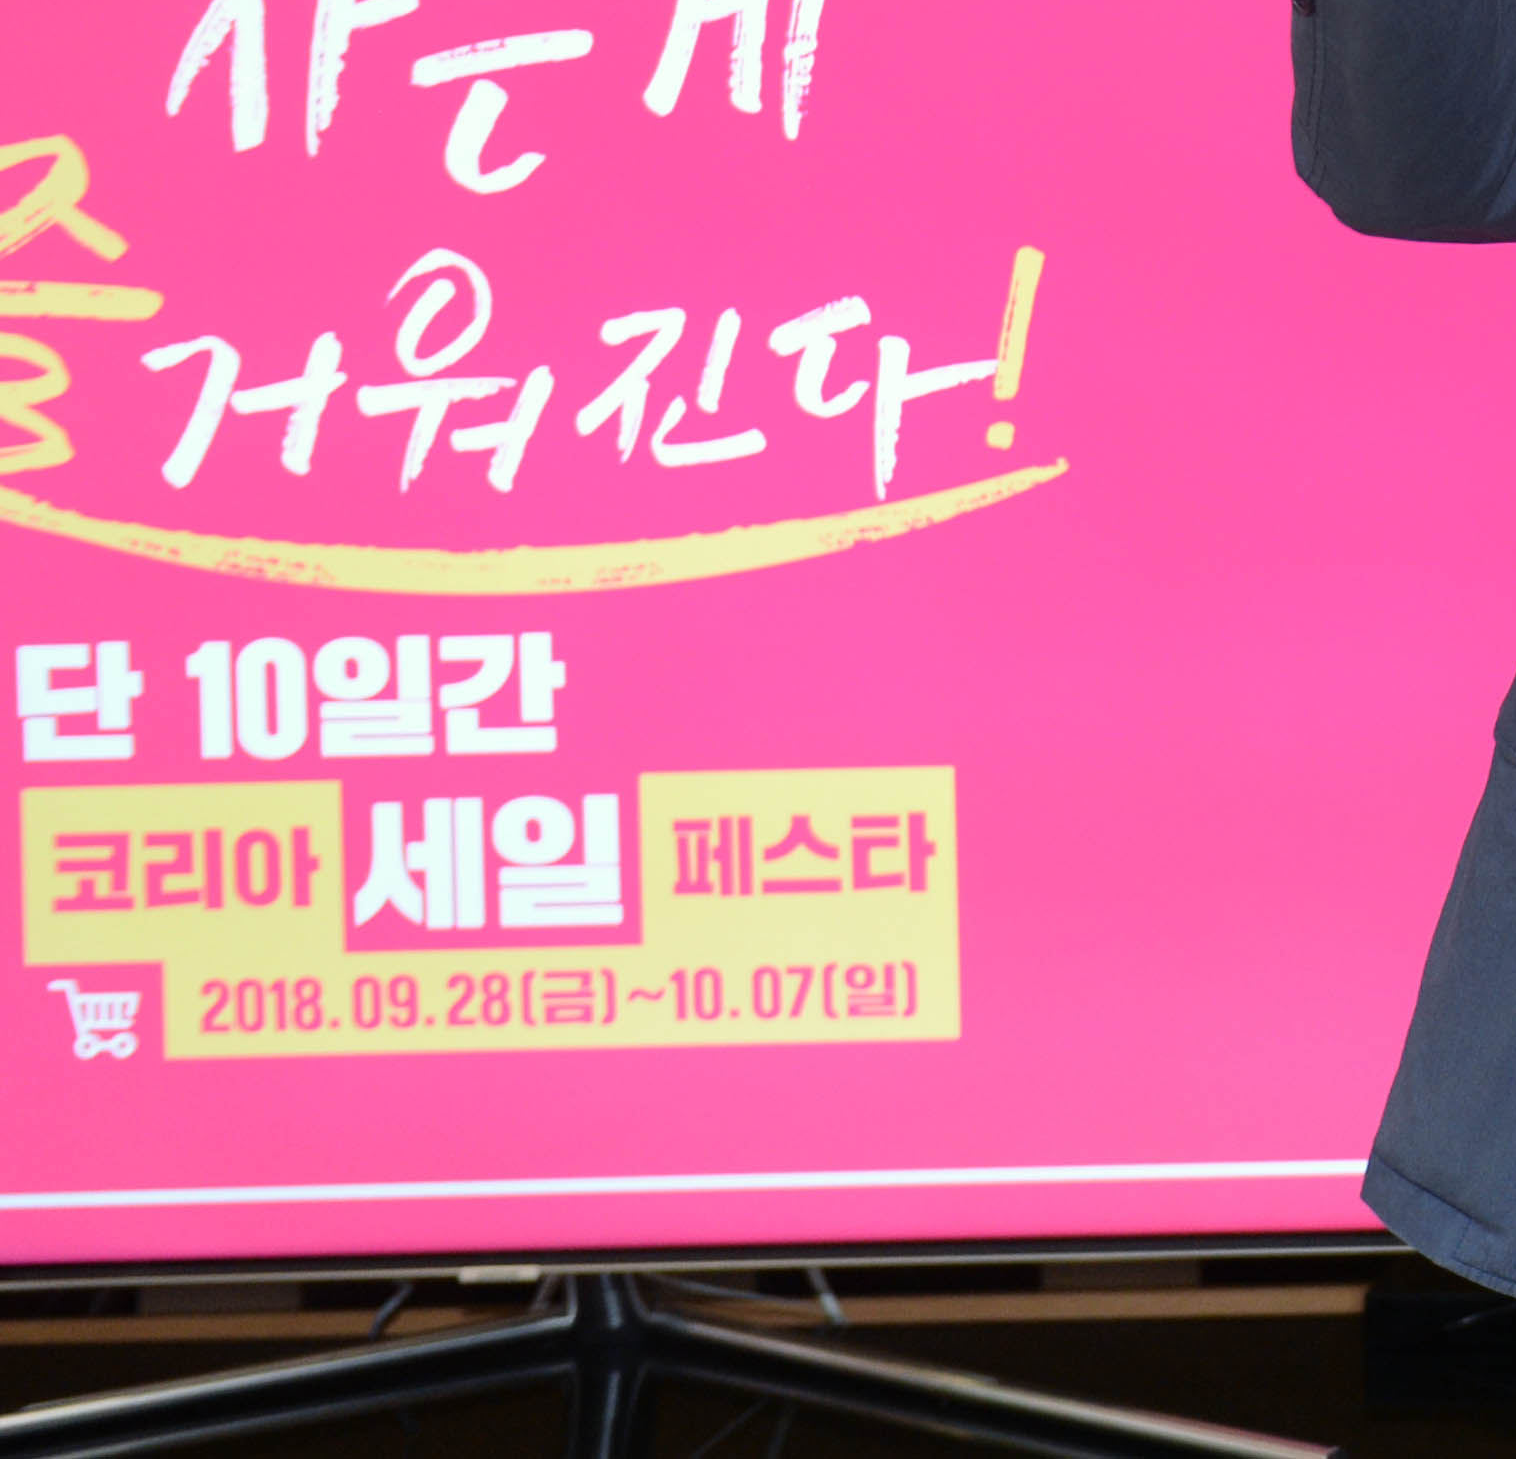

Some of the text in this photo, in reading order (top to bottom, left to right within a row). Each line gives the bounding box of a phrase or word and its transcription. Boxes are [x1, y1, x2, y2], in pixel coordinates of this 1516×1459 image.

[15, 632, 566, 762] 단 10일간
[51, 793, 936, 931] 코리아 세일 페스타
